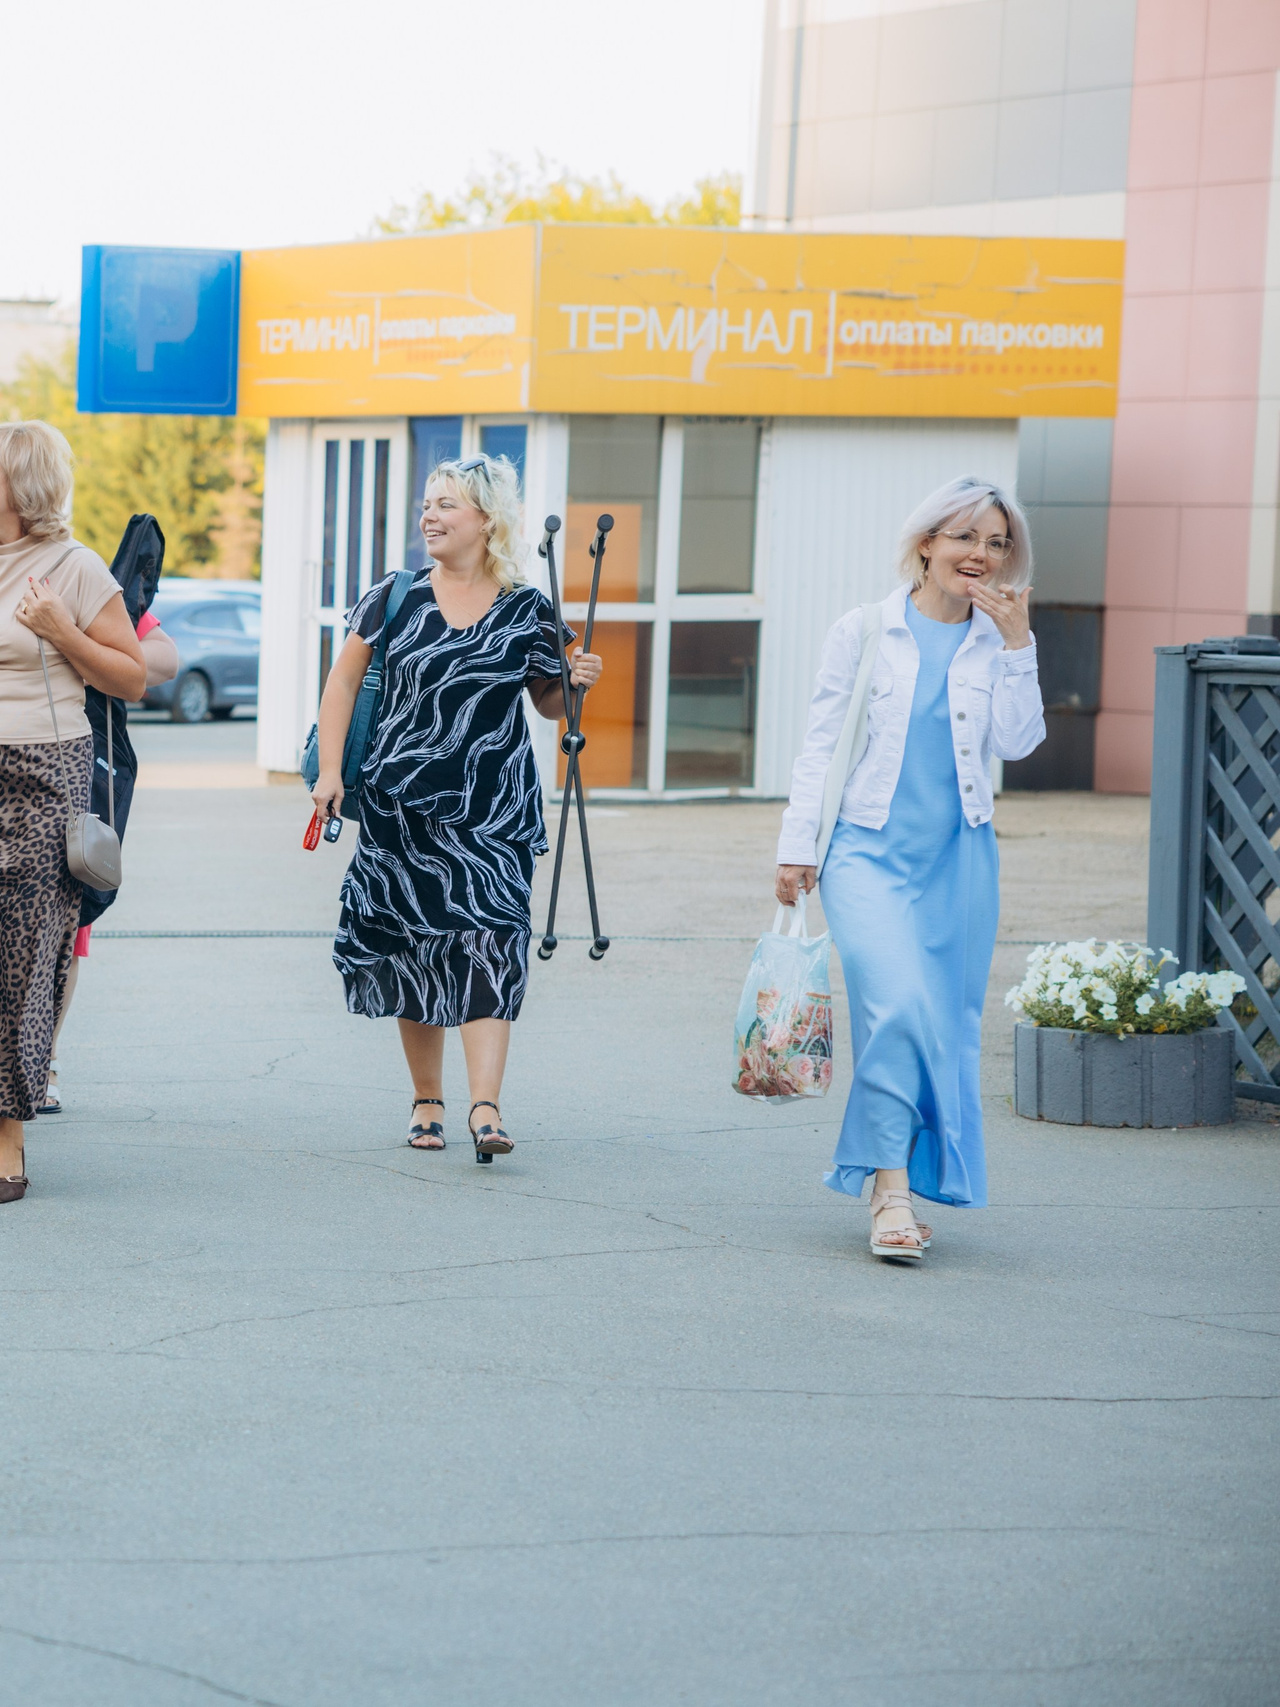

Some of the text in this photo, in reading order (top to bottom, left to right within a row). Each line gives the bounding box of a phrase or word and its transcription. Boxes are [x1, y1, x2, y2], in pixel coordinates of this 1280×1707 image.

[257, 313, 370, 355] ТЕРМИНАЛ
[559, 304, 1104, 355] ТЕРМИНАЛ оплаты парковки
